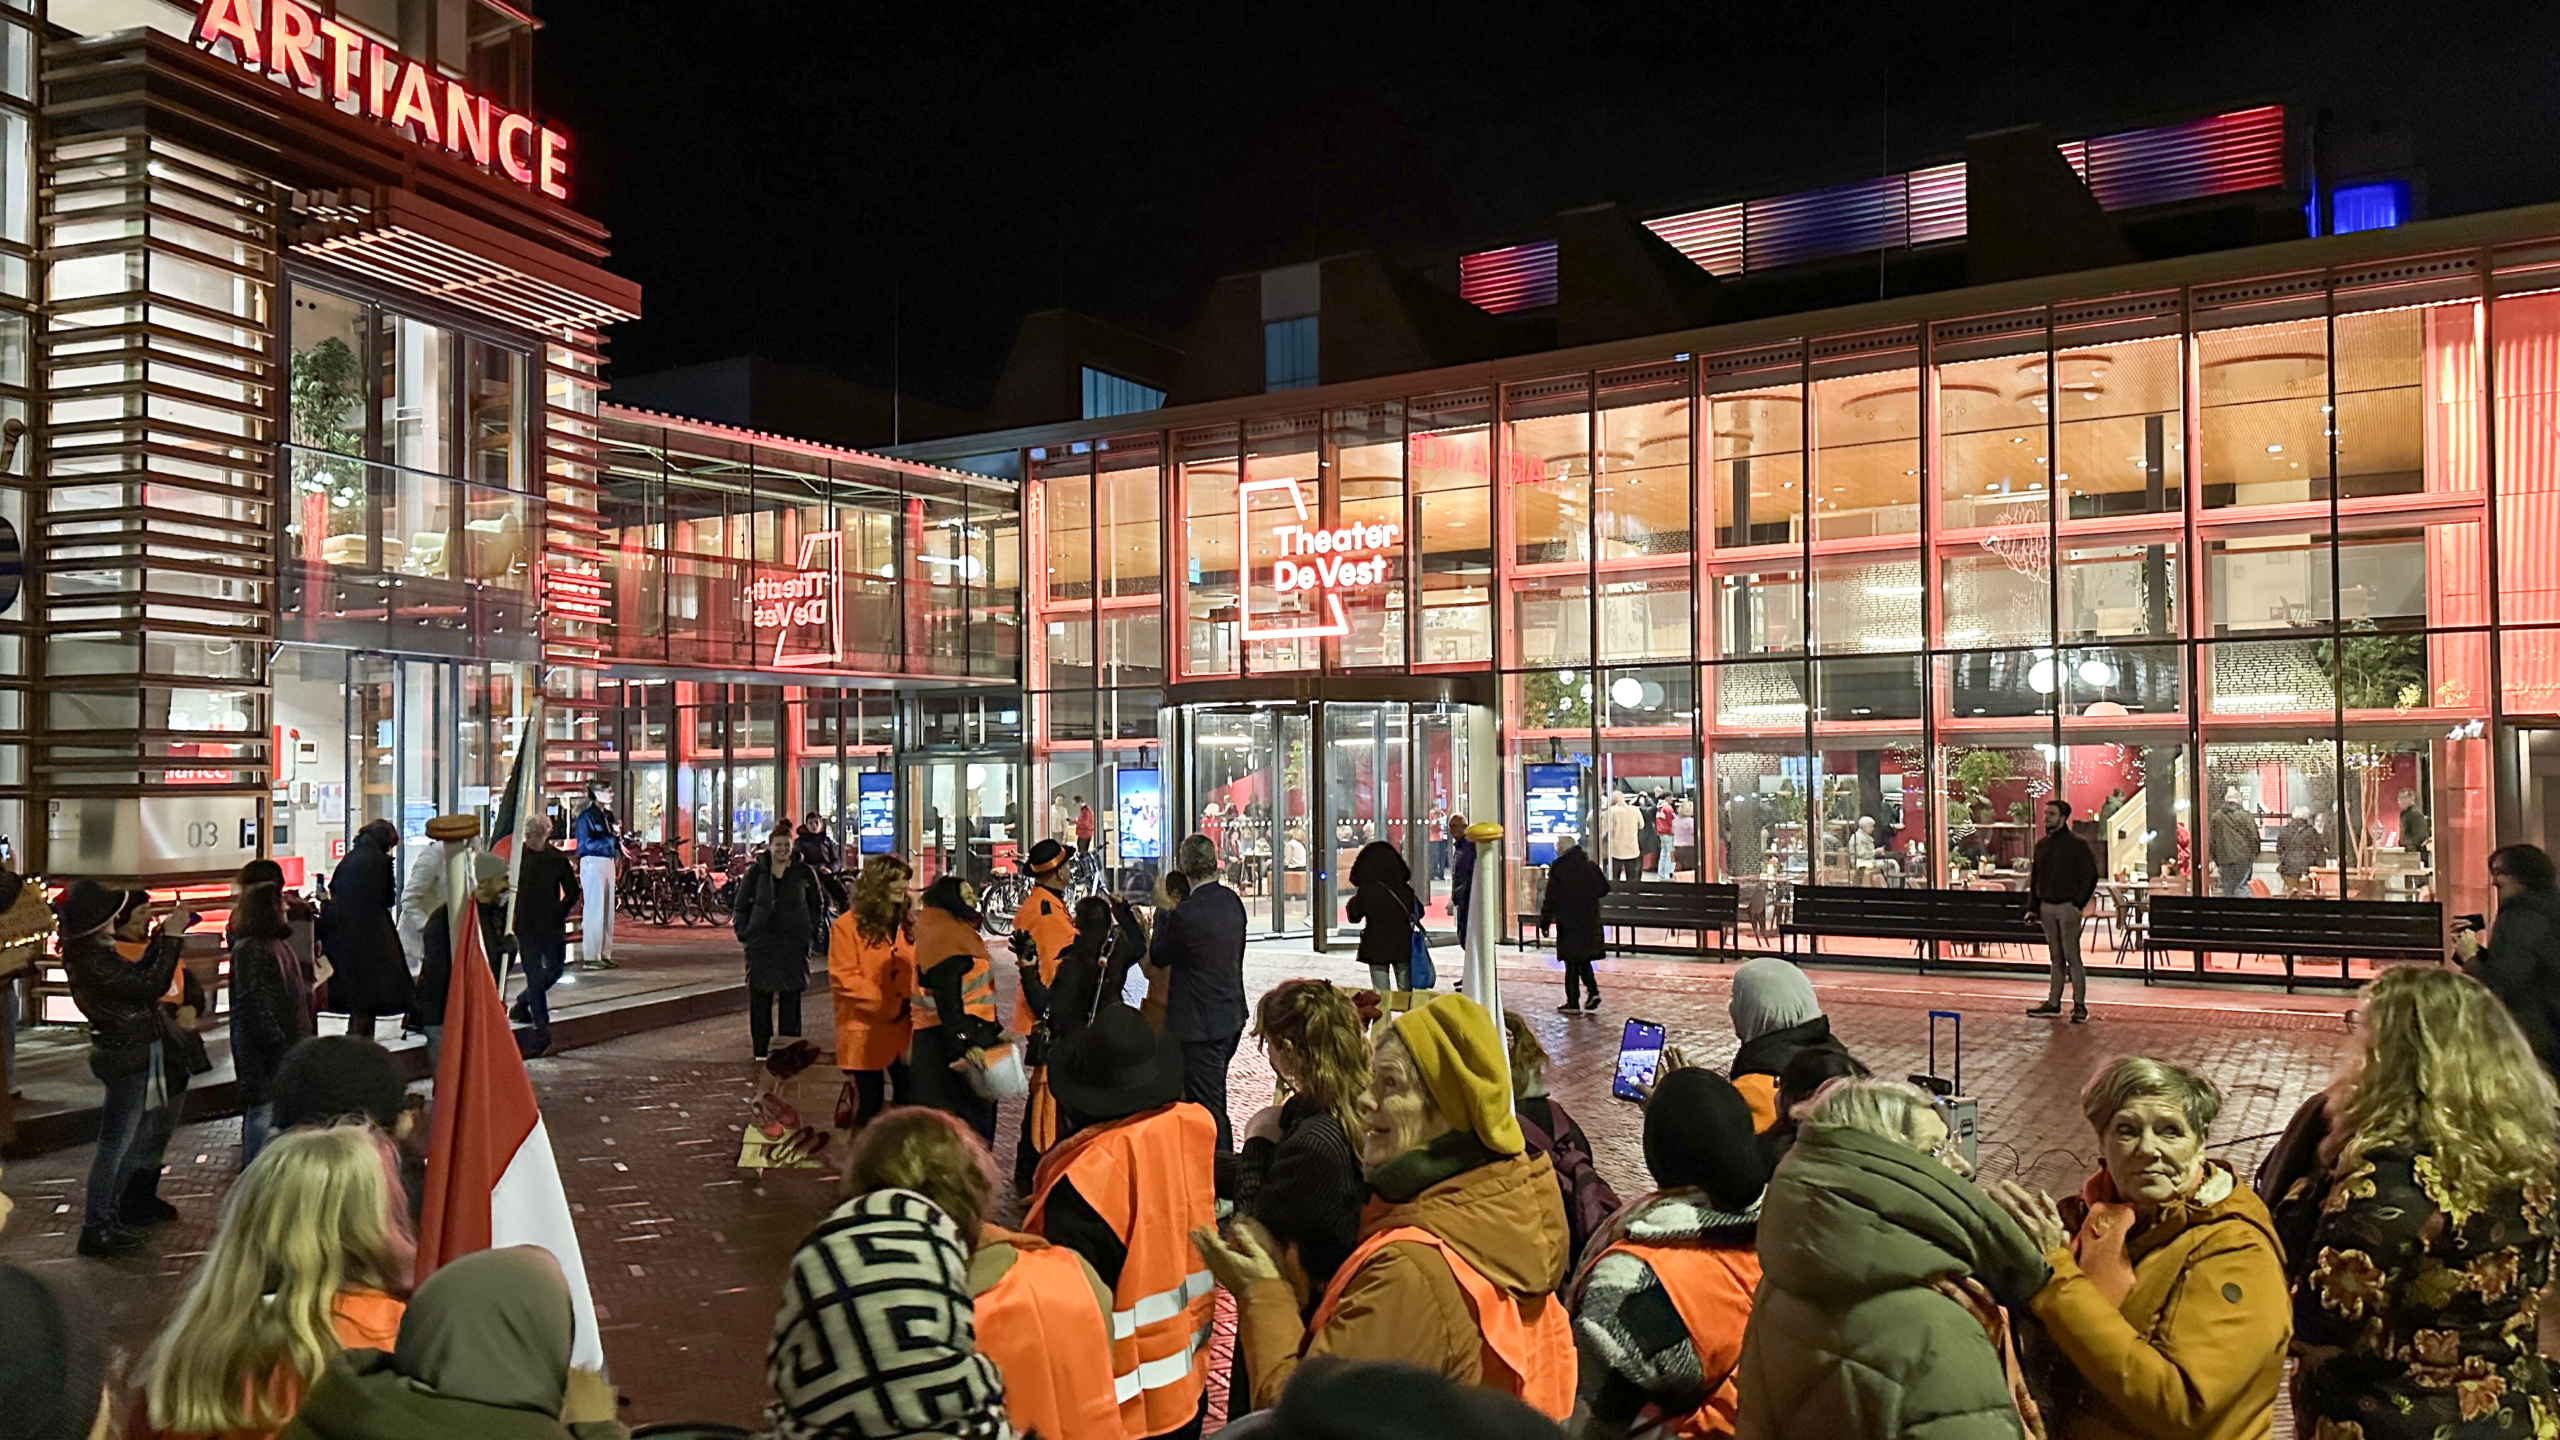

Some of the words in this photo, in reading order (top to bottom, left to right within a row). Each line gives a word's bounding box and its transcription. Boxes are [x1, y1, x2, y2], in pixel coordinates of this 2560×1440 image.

[200, 0, 567, 200] ARTIANCE
[1272, 520, 1399, 557] Theater
[187, 821, 219, 849] 03
